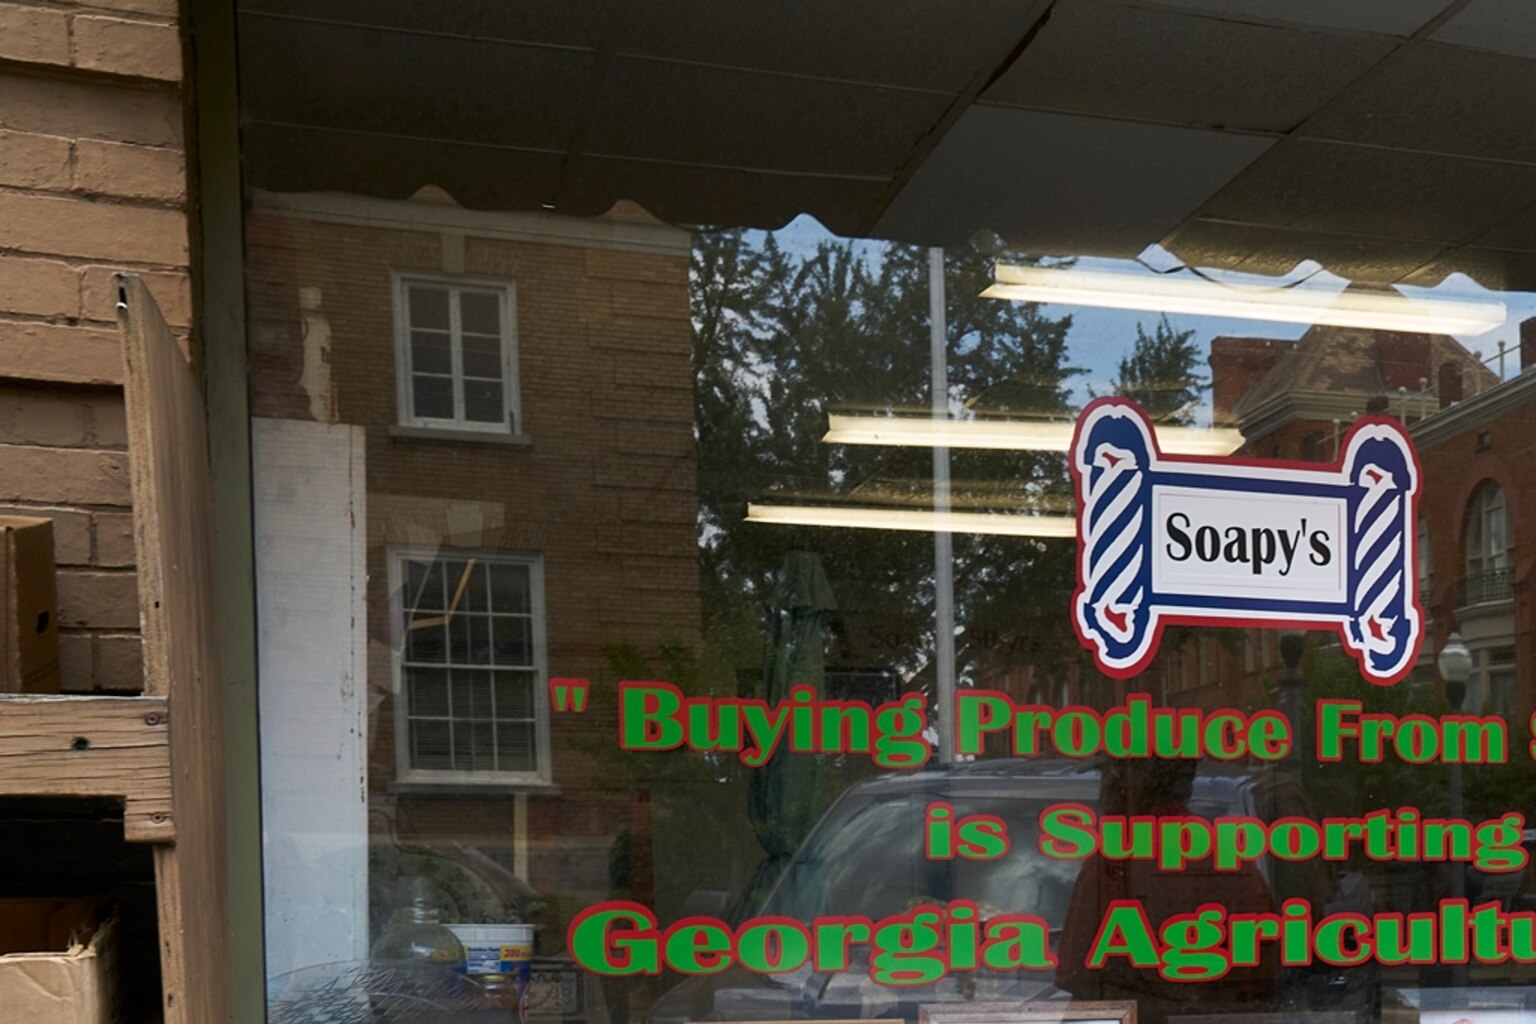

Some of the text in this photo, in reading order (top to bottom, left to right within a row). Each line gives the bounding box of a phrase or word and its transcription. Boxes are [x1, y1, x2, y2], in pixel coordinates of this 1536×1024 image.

[1165, 511, 1332, 577] Soapy's
[618, 680, 931, 768] Buying
[955, 689, 1293, 761] Produce
[1316, 699, 1508, 765] From
[925, 800, 1530, 874] is Supporting
[567, 900, 1058, 988] Georgia
